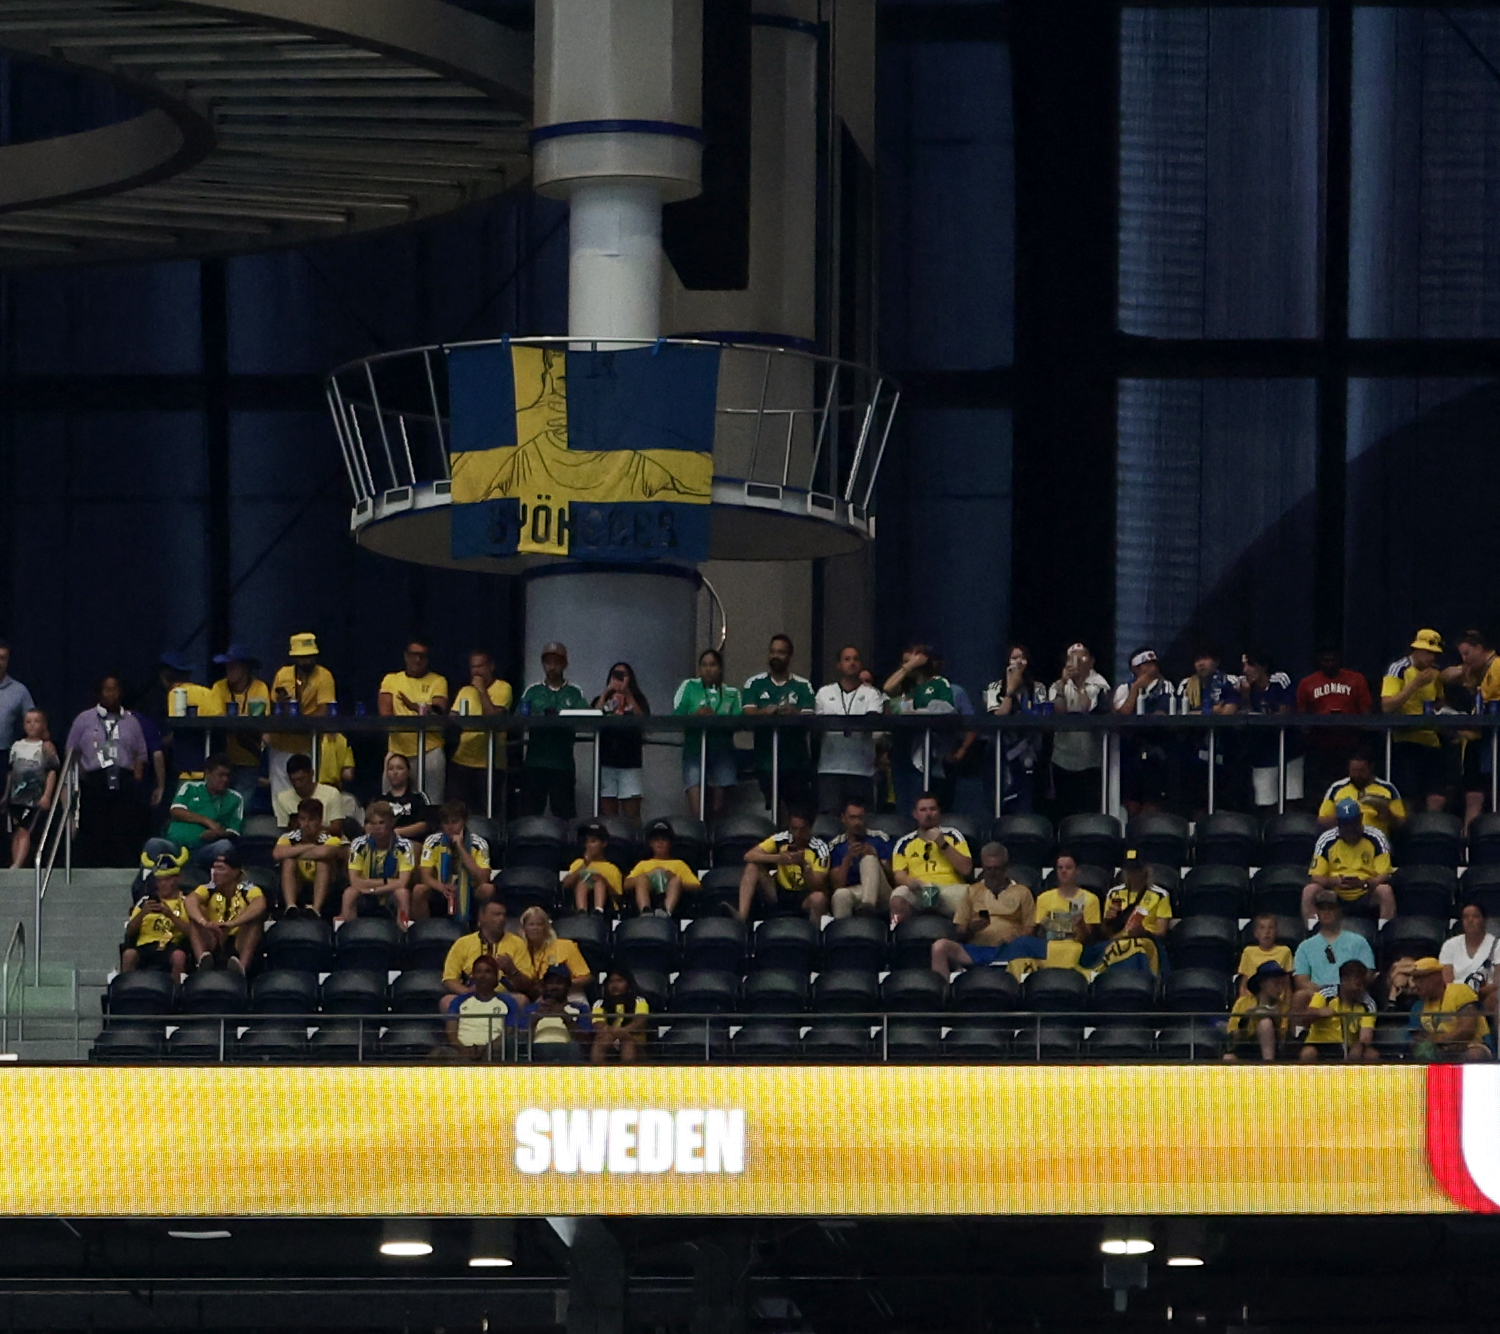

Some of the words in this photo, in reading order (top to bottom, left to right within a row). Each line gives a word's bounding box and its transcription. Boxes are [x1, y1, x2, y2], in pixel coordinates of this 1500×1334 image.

[1313, 683, 1331, 699] OLD
[1331, 682, 1352, 696] NAVY
[515, 1108, 746, 1175] SWEDEN
